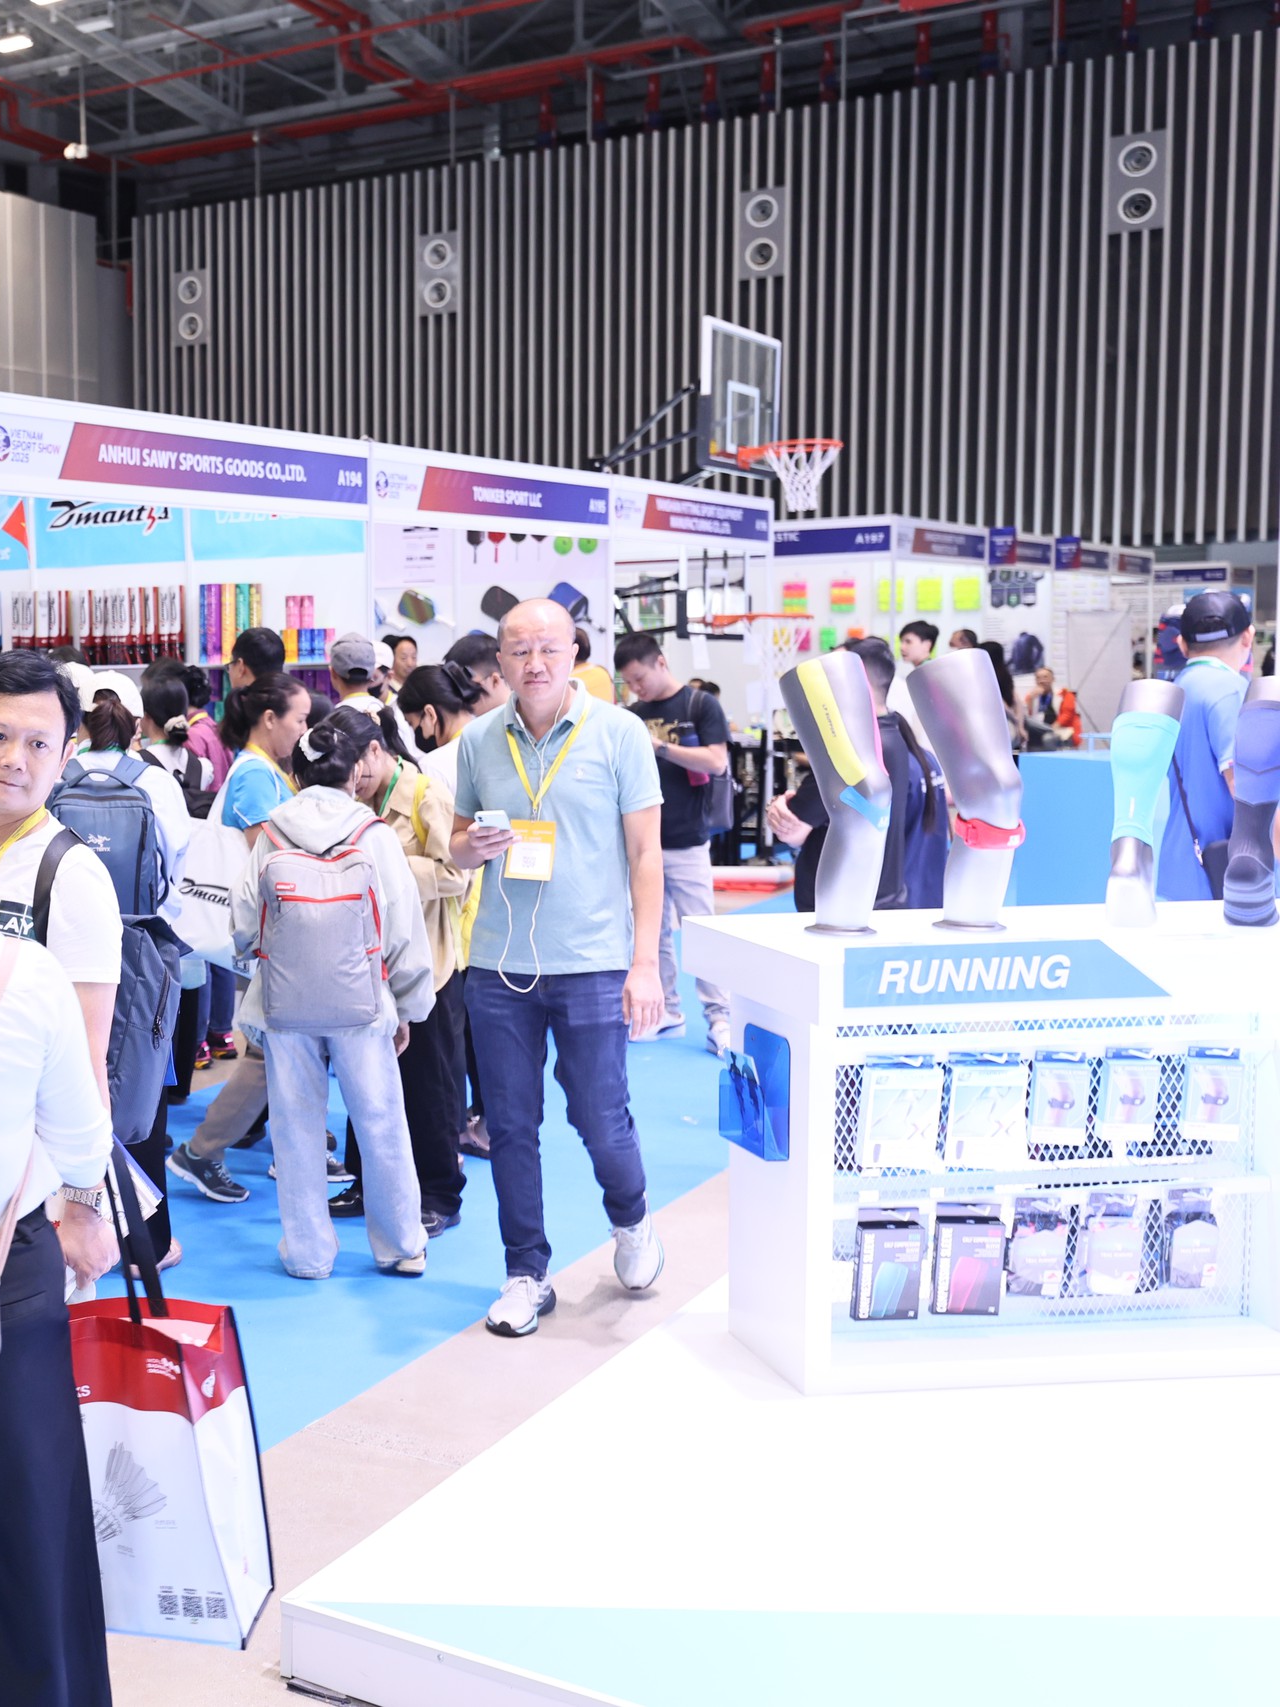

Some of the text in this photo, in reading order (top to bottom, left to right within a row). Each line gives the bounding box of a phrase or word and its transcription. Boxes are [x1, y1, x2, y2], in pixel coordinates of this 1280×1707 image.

[10, 429, 43, 441] VIETNAM
[11, 441, 61, 455] SPORT SHOW
[11, 452, 29, 463] 2025
[98, 443, 140, 466] ANHUI
[142, 449, 179, 470] SAWY
[179, 452, 223, 475] SPORTS
[224, 457, 265, 479] GOODS
[337, 469, 363, 488] A194
[878, 954, 1071, 995] RUNNING
